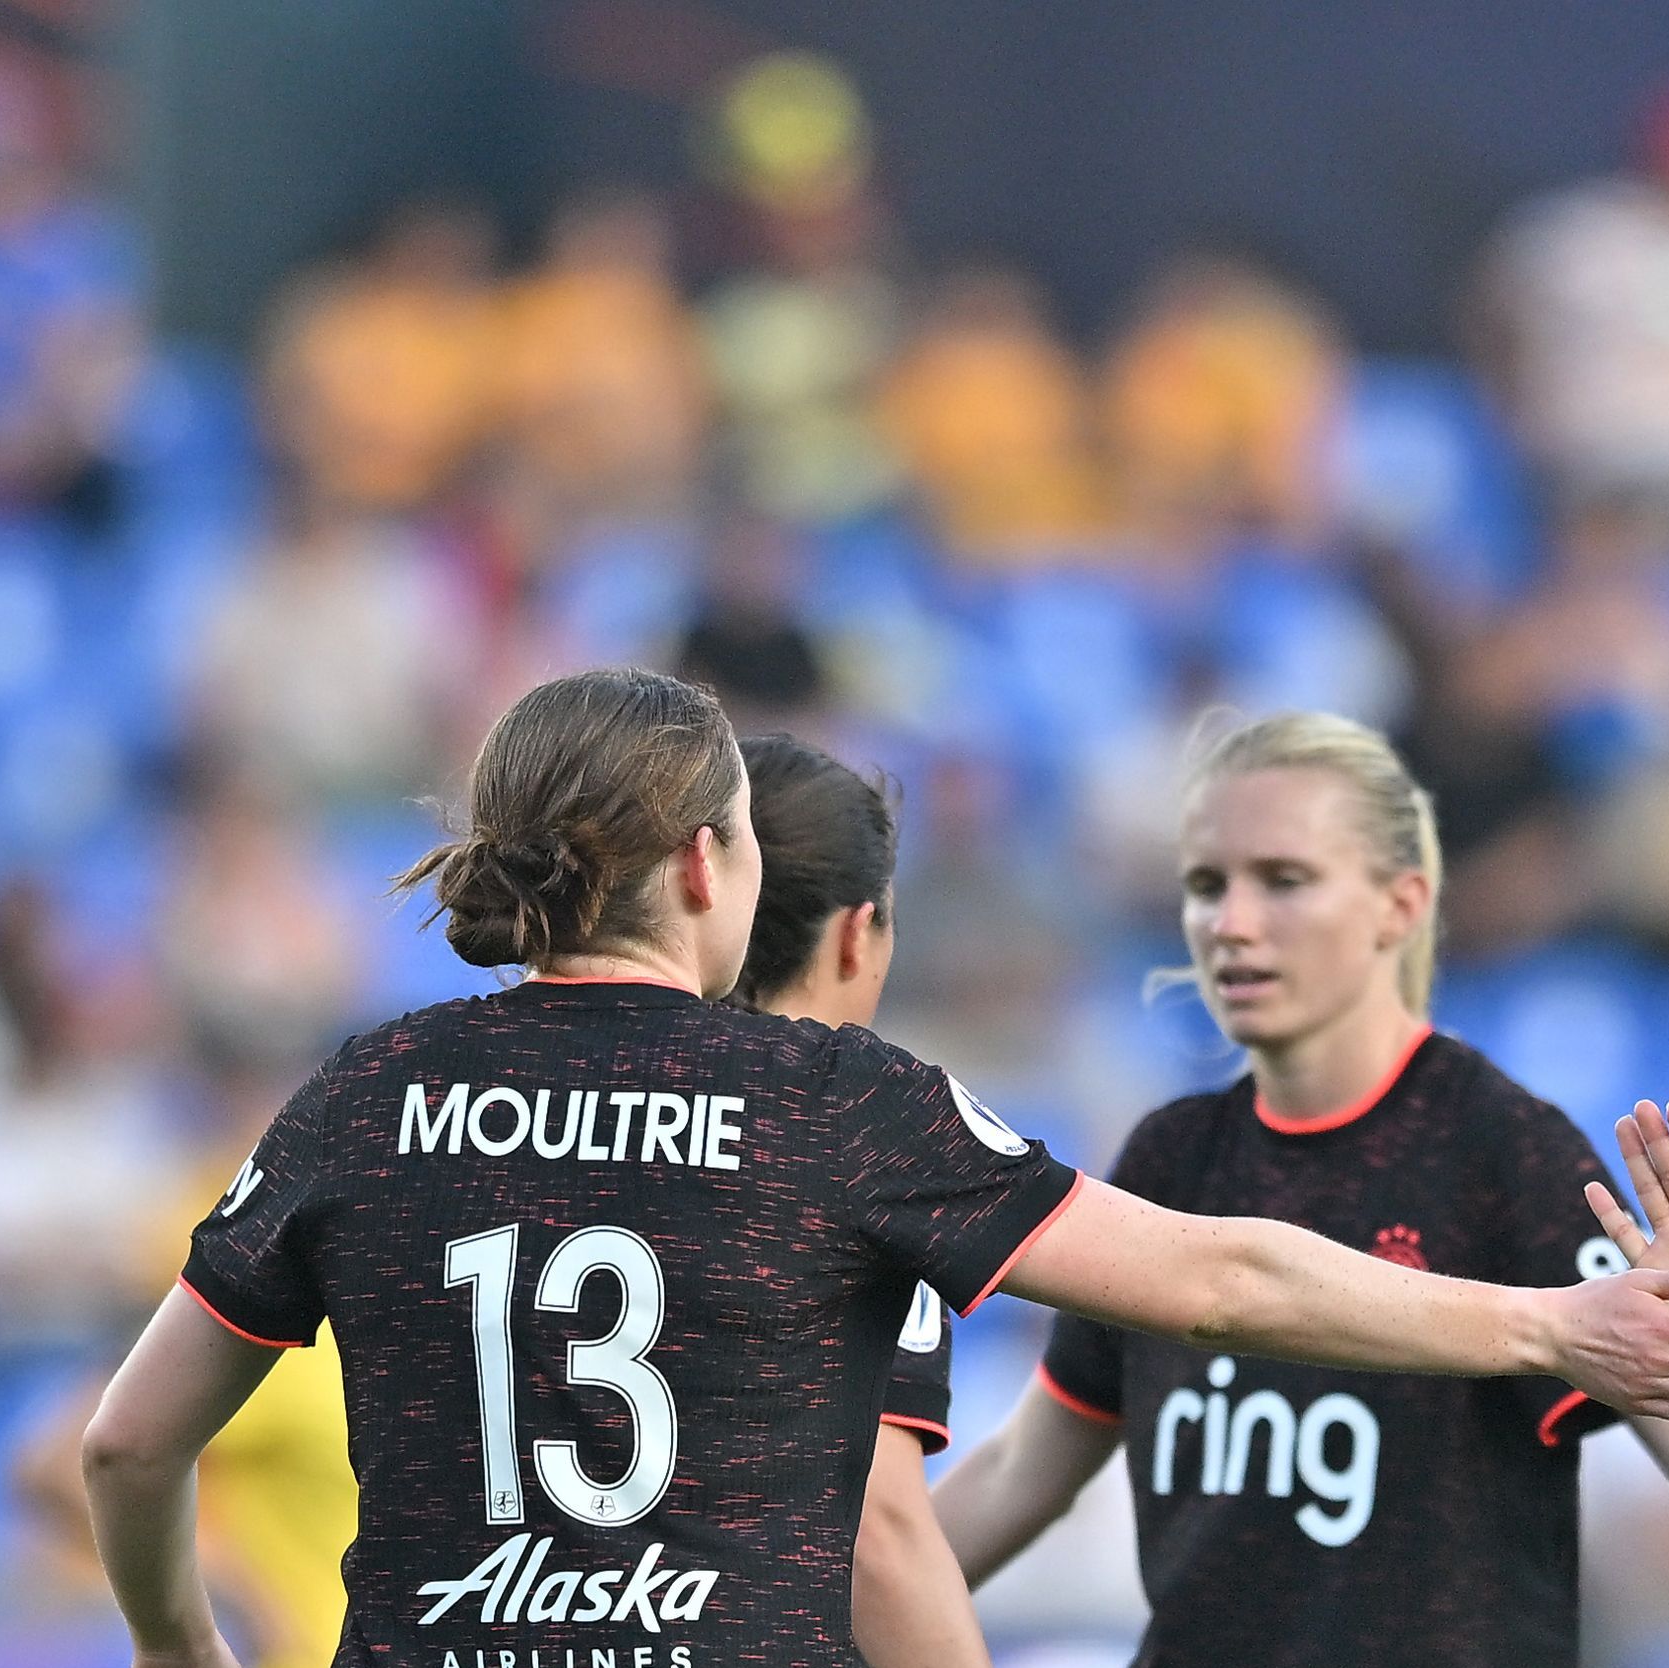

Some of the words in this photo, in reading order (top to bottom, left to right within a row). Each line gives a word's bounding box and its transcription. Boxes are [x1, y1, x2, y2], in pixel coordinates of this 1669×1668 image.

[397, 1082, 746, 1172] MOULTRIE
[442, 1222, 679, 1527] 13
[1152, 1355, 1381, 1548] ring
[415, 1532, 721, 1634] Alaska
